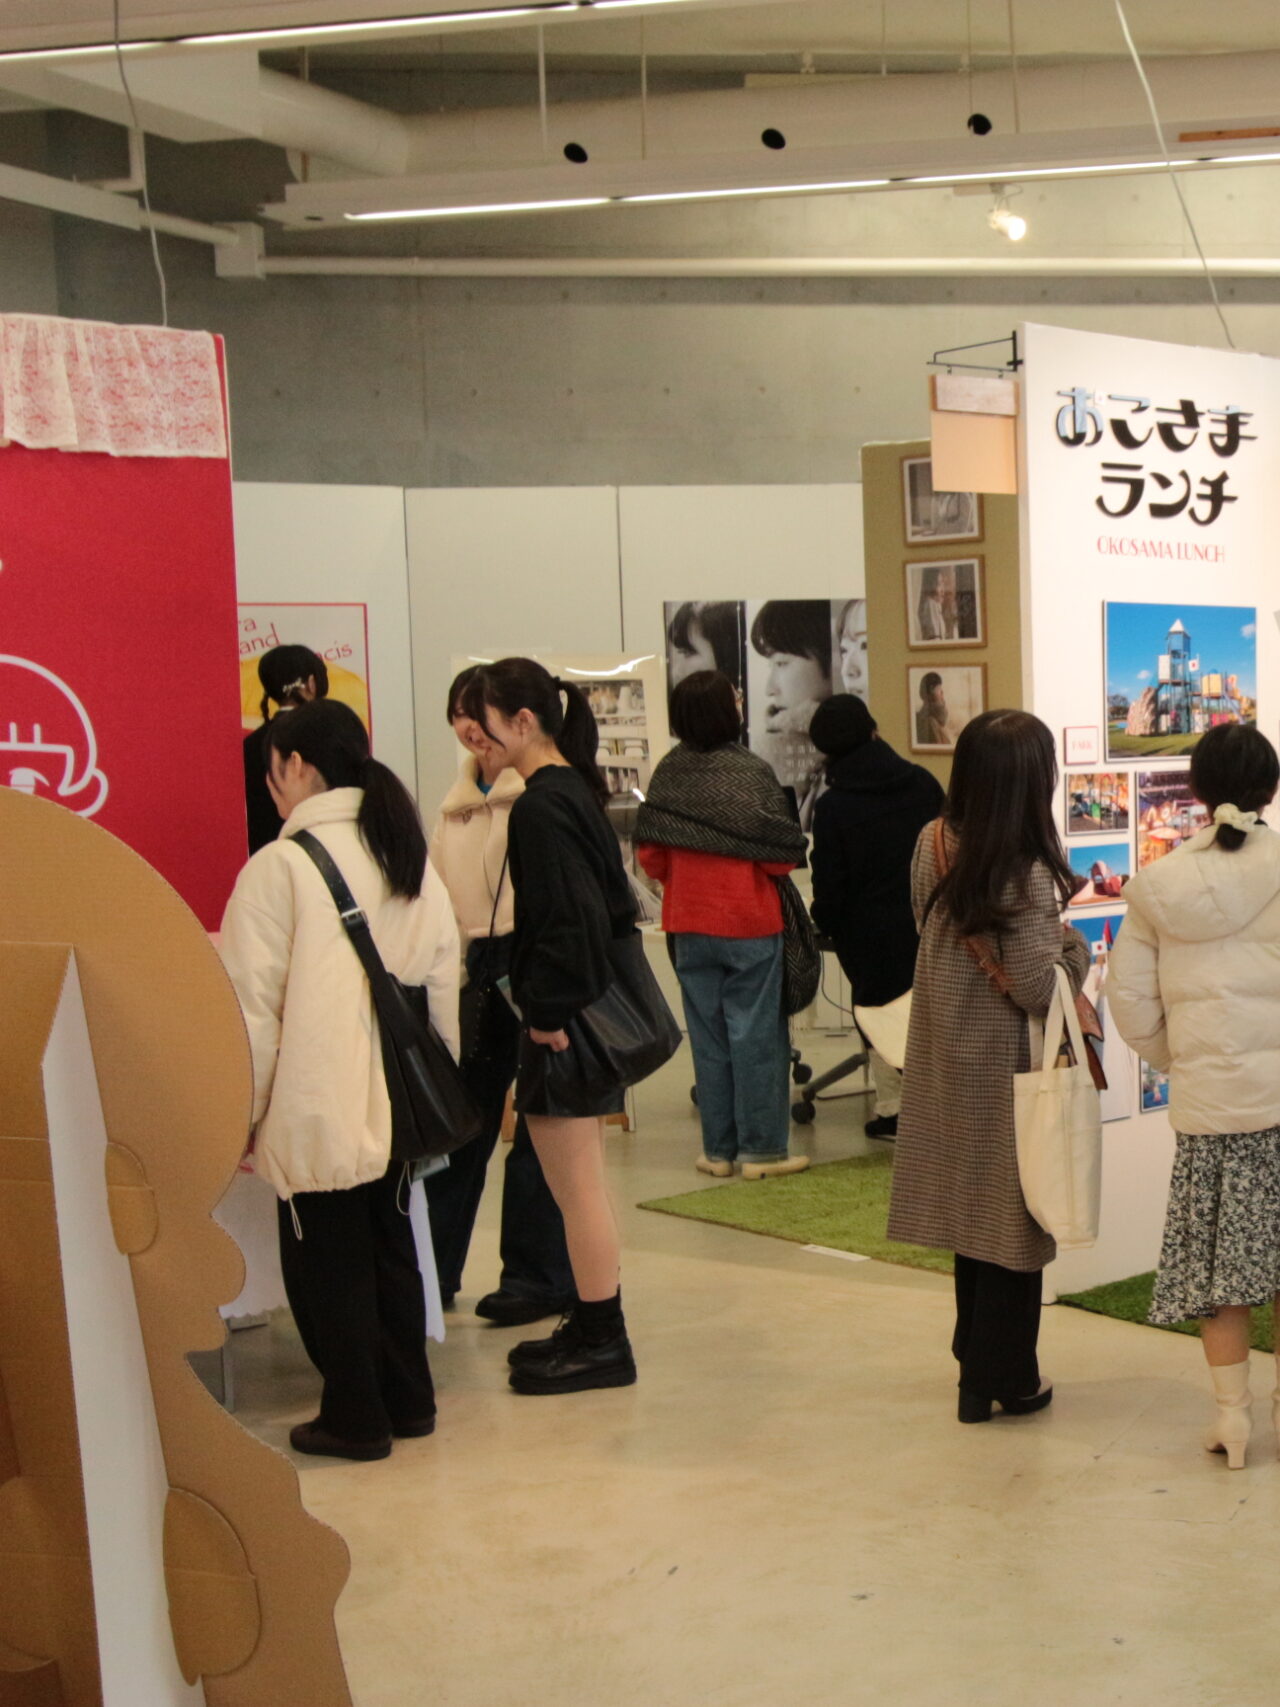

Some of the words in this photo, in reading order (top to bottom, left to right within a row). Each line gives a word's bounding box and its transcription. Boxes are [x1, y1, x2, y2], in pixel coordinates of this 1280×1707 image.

[1056, 387, 1258, 458] おこさま
[1096, 462, 1238, 526] ランチ
[1097, 535, 1173, 559] OKOSAMA
[1177, 543, 1225, 562] LUNCH
